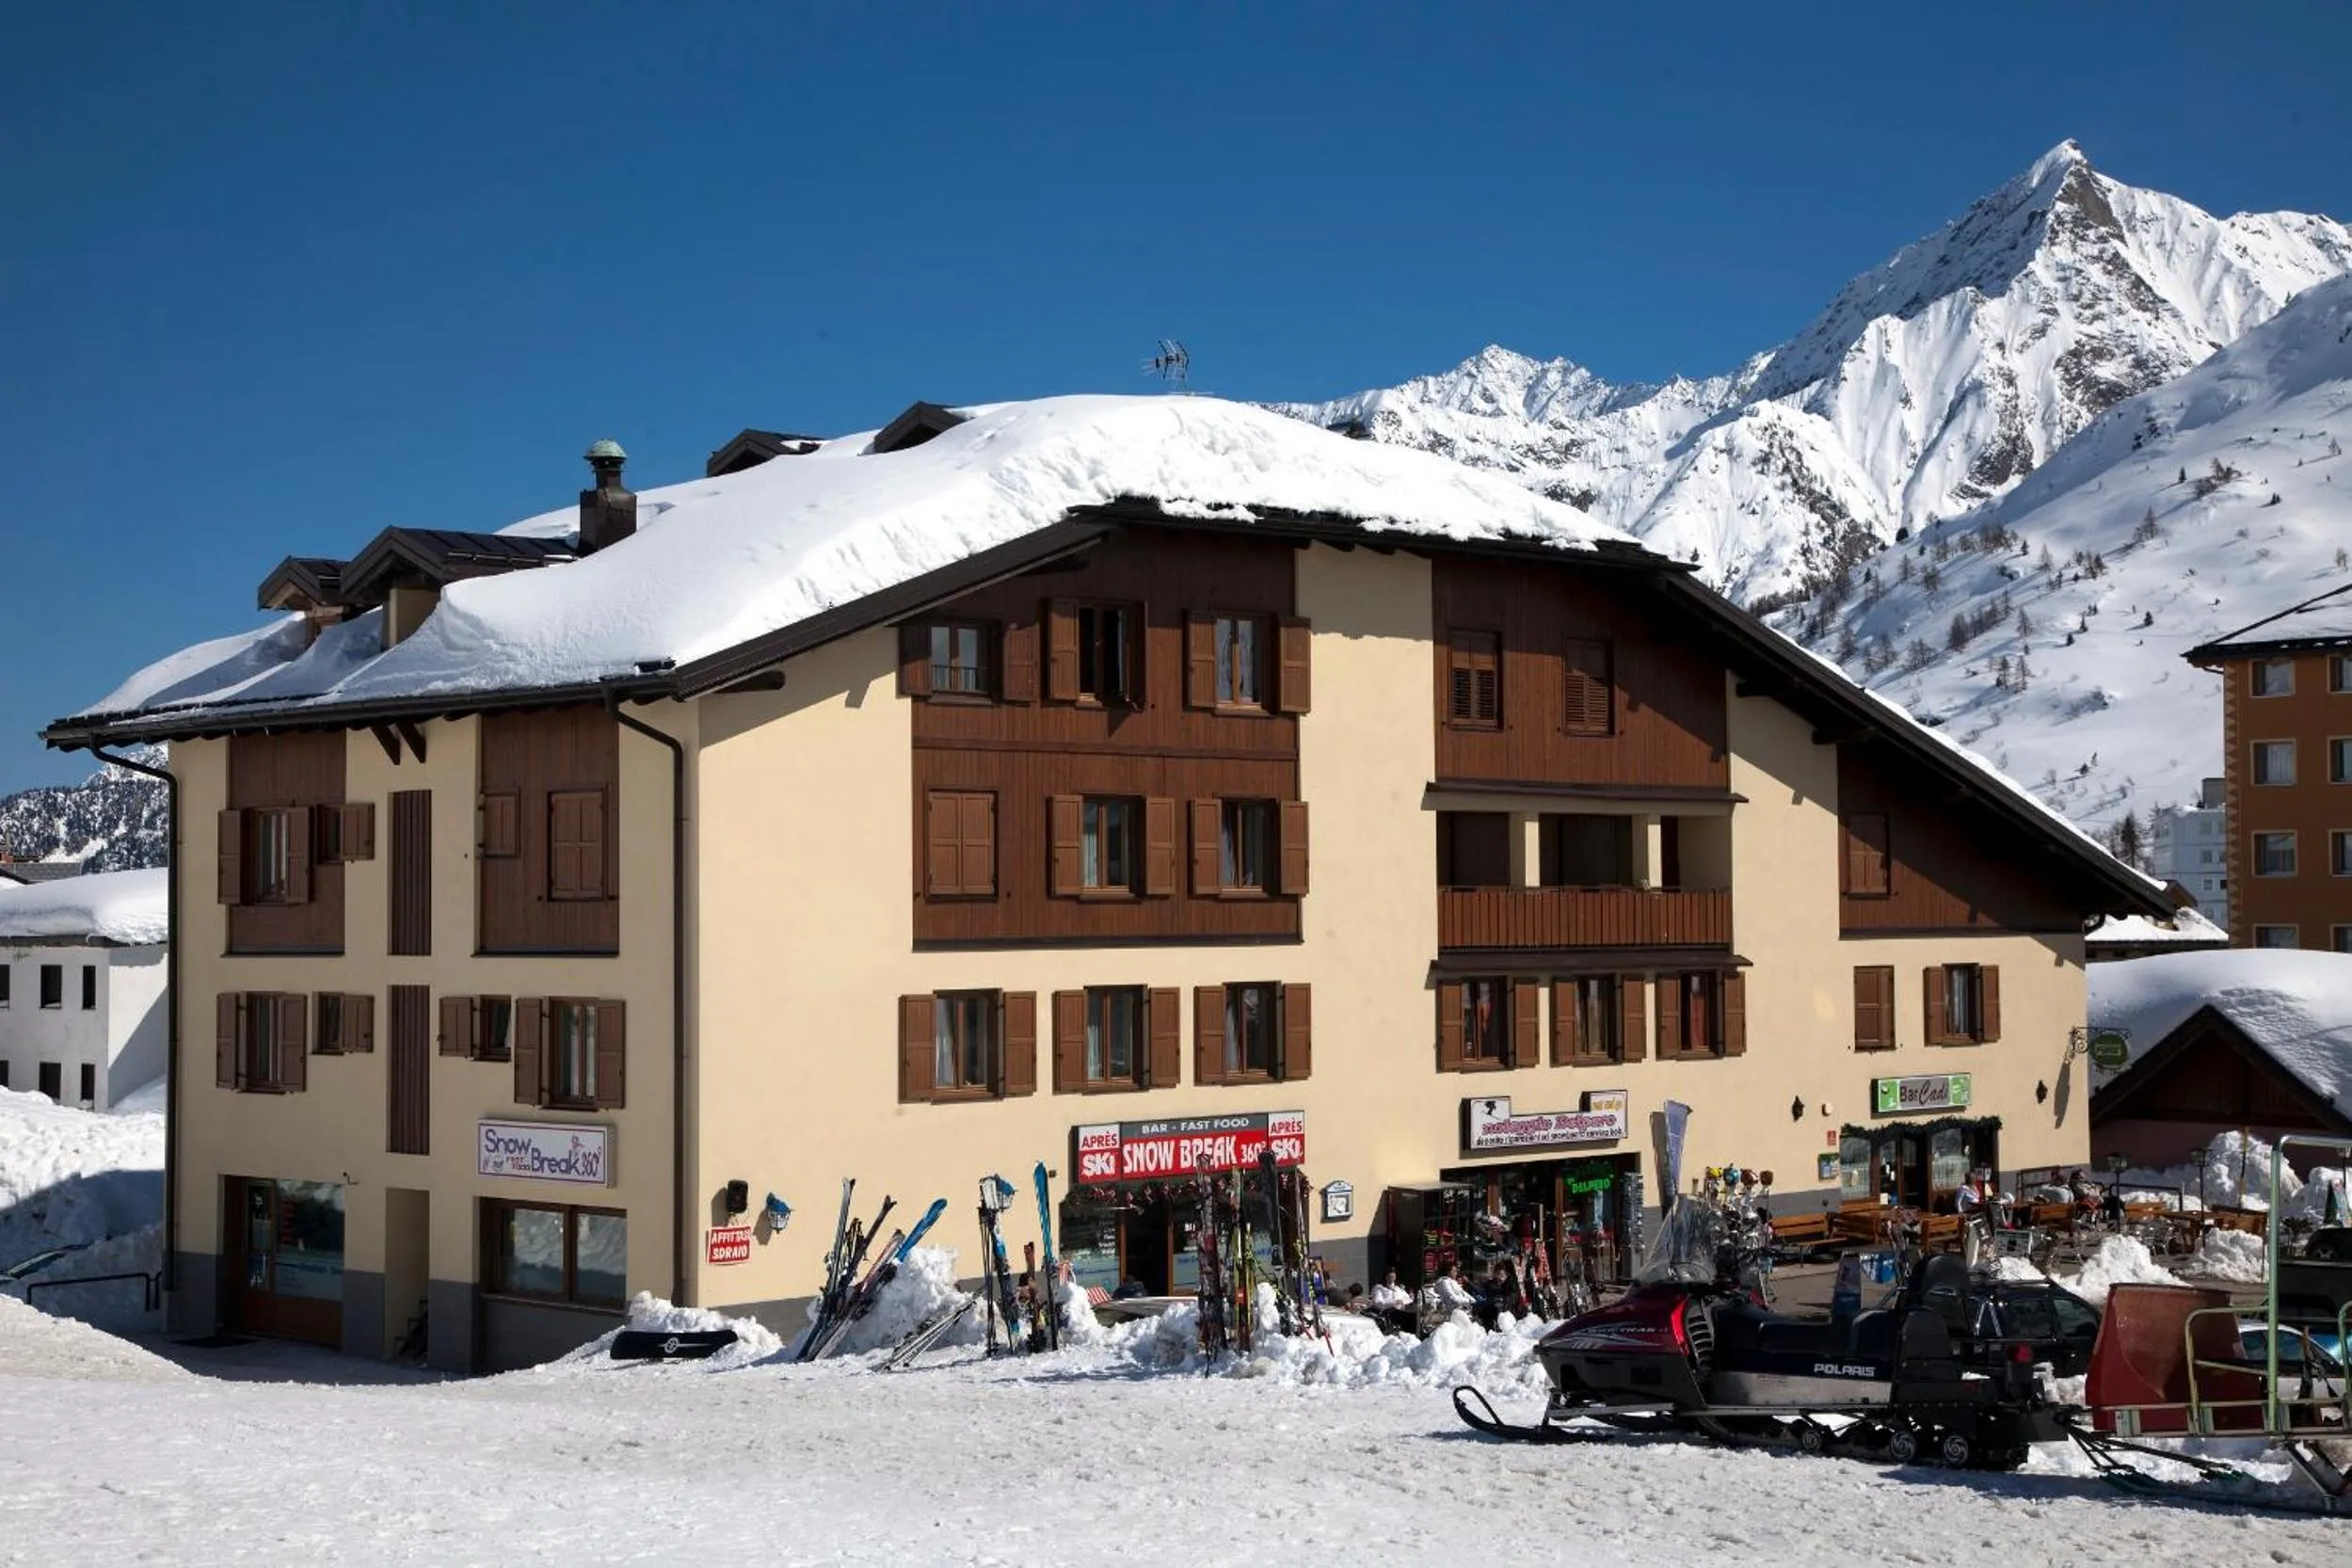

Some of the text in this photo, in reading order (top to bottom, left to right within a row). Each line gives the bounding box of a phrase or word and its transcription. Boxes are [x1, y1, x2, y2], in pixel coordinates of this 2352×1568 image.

[1142, 1123, 1168, 1135] BAR
[1180, 1120, 1211, 1131] FAST
[1213, 1117, 1250, 1128] FOOD
[1270, 1117, 1303, 1134] APRÈS
[485, 1128, 532, 1154] Snow
[1081, 1130, 1117, 1148] APRÈS
[531, 1147, 581, 1176] Break
[1122, 1139, 1176, 1174] SNOW
[1179, 1134, 1238, 1169] BREAK
[1813, 1362, 1876, 1377] POLARIS
